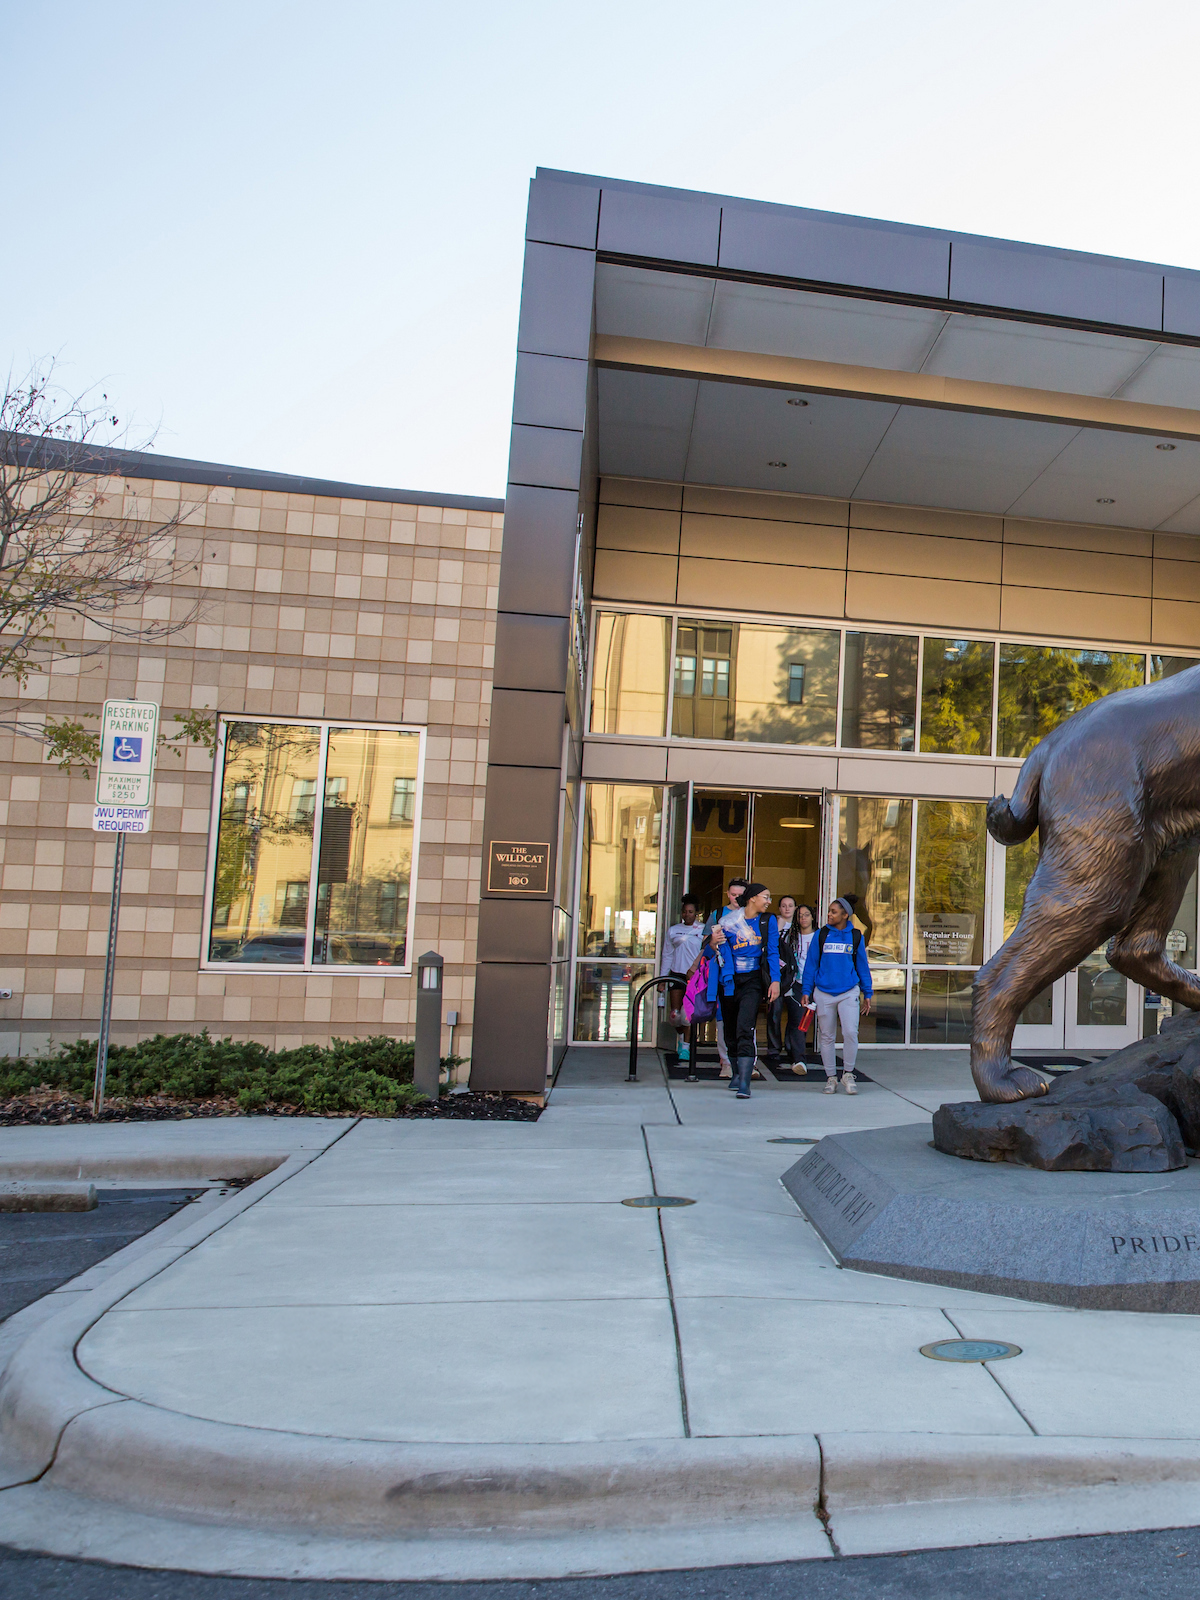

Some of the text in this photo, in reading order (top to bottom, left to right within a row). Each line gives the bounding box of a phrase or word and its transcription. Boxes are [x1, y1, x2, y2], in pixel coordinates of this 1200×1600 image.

[107, 706, 154, 720] RESERVED
[110, 720, 149, 732] PARKING
[108, 776, 142, 784] MAXIMUM
[108, 783, 141, 791] PENALTY
[112, 791, 136, 799] $250
[94, 807, 149, 819] JWU PERMIT
[97, 820, 144, 832] REQUIRED
[496, 853, 544, 864] WILDCAT
[923, 931, 951, 940] Regular
[800, 1151, 876, 1226] THE WILDCAT WAY
[1110, 1234, 1200, 1255] PRIDE
